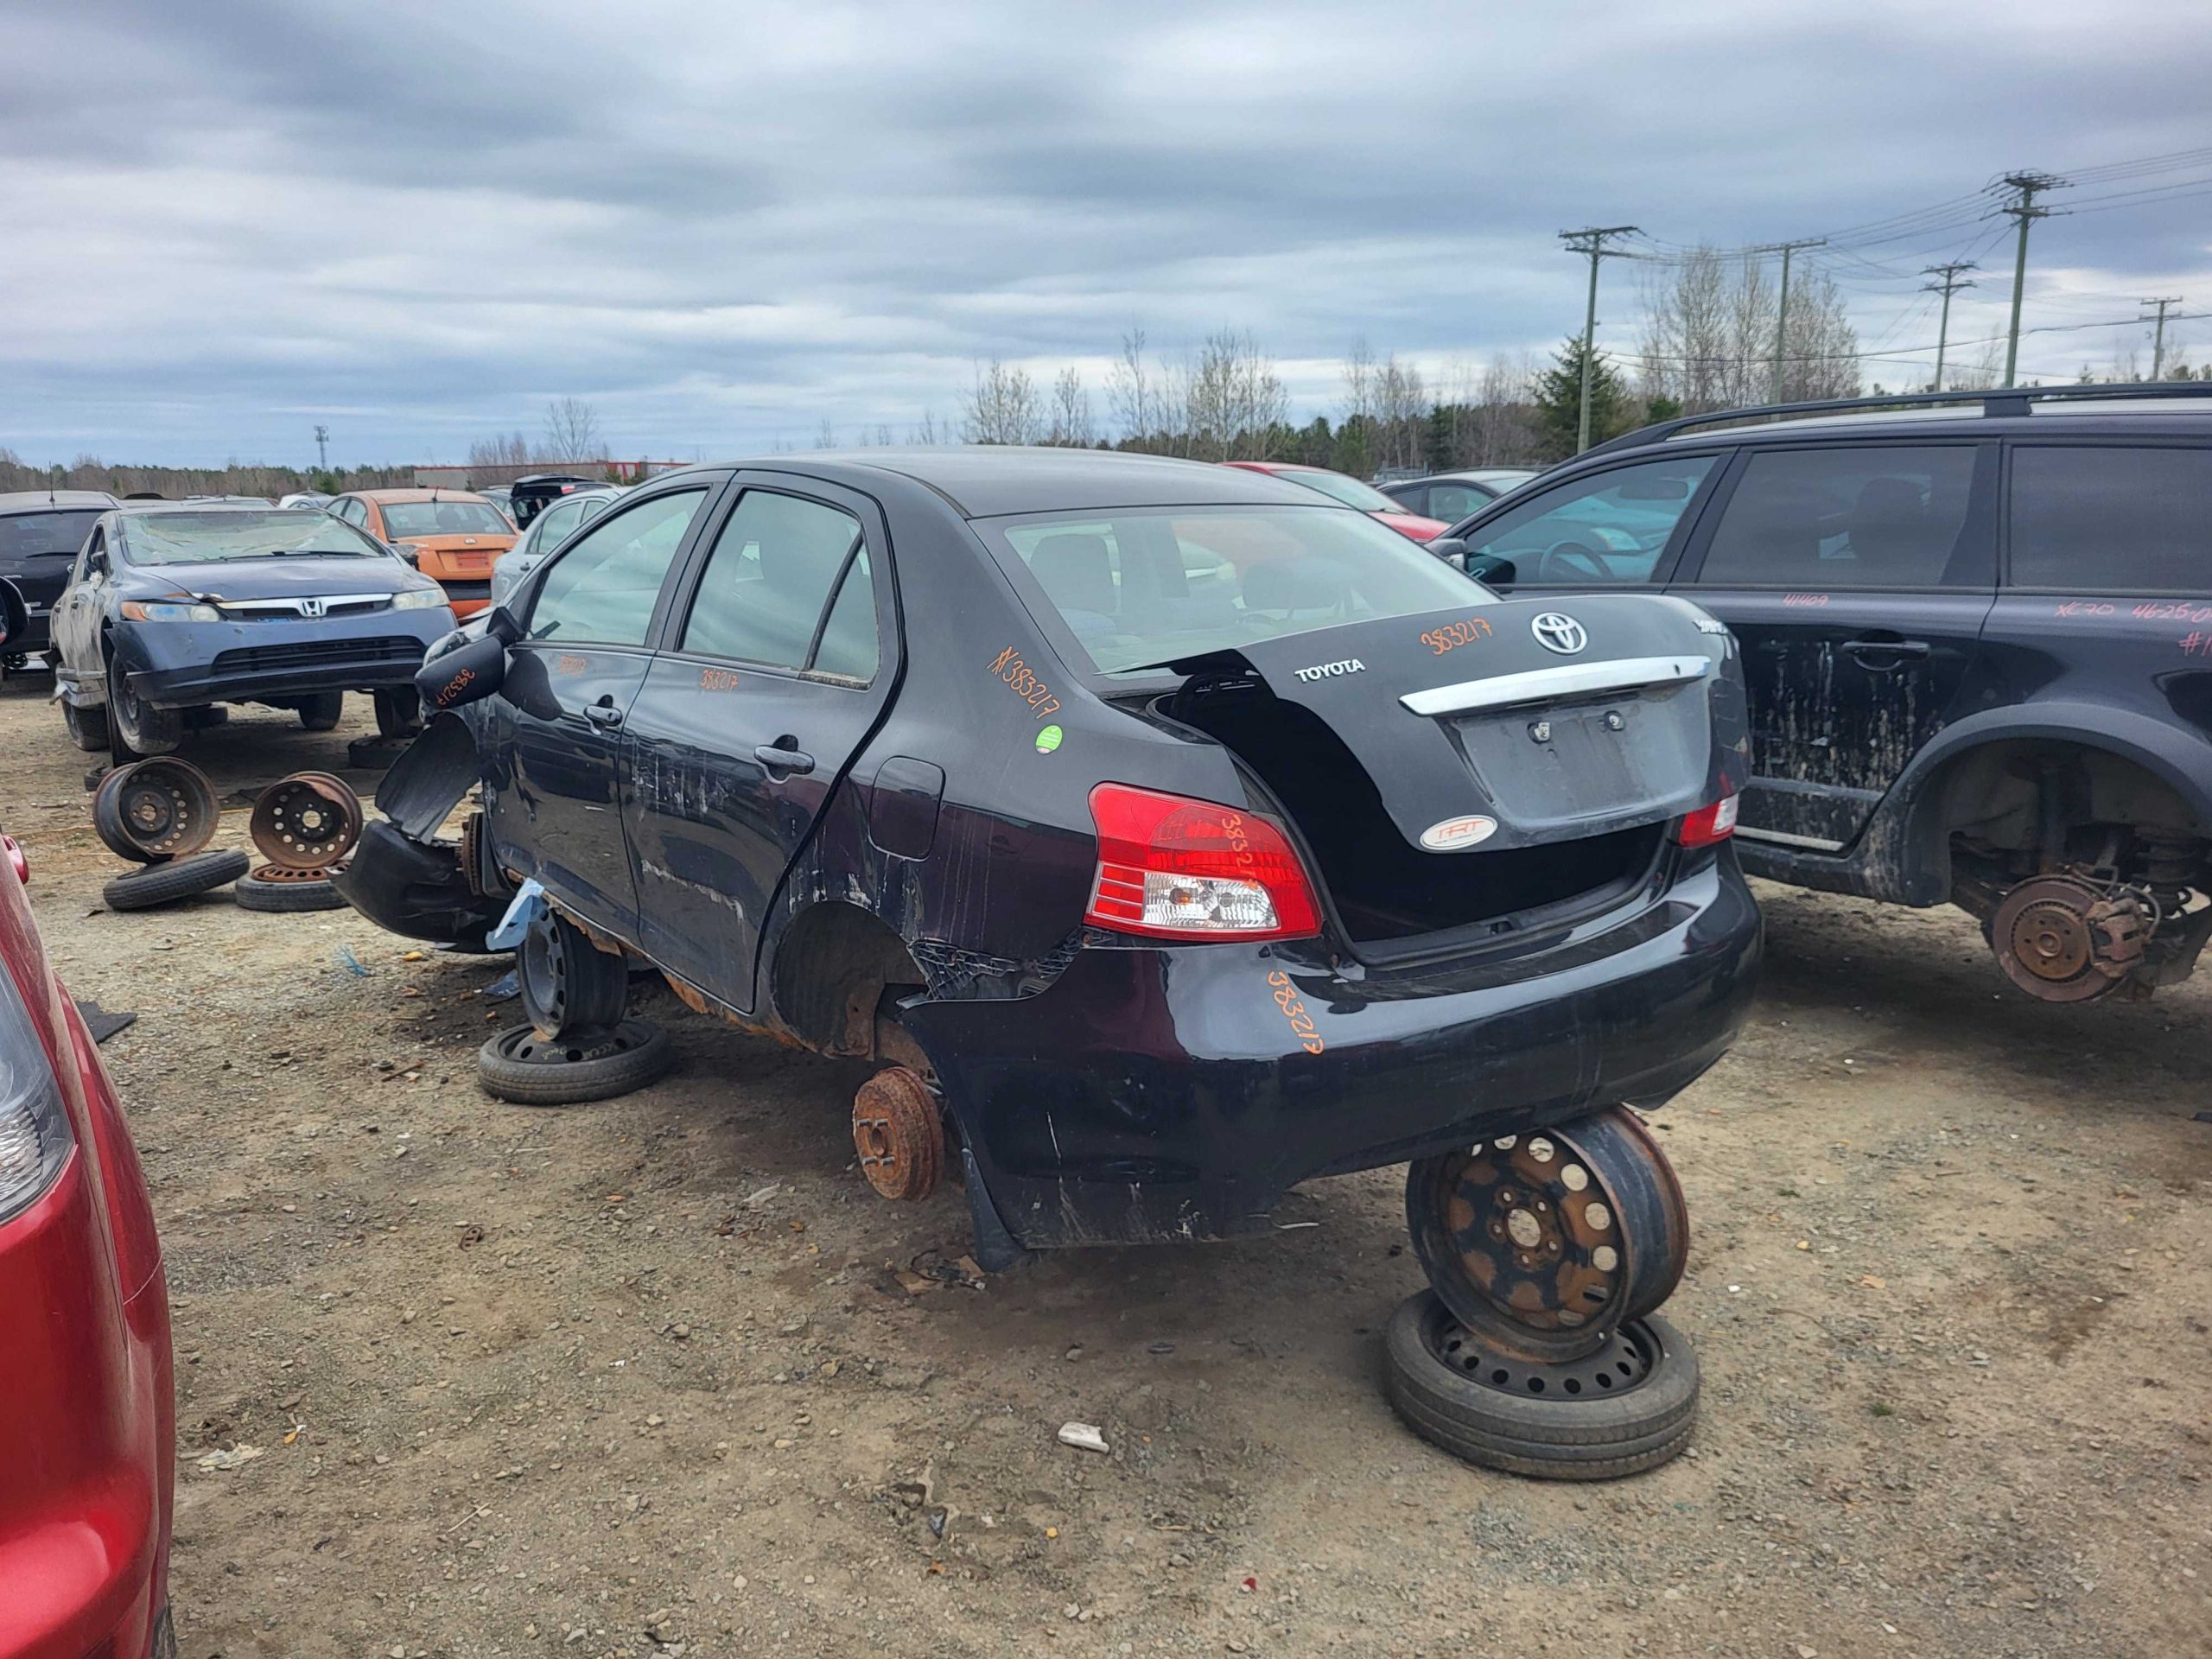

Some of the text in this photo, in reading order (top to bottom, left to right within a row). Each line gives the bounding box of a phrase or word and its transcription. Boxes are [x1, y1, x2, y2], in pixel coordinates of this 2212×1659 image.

[2132, 602, 2212, 623] 46-25-0
[1421, 618, 1492, 655] 383217
[1294, 658, 1365, 683] TOYOTA
[1268, 970, 1324, 1054] 383217
